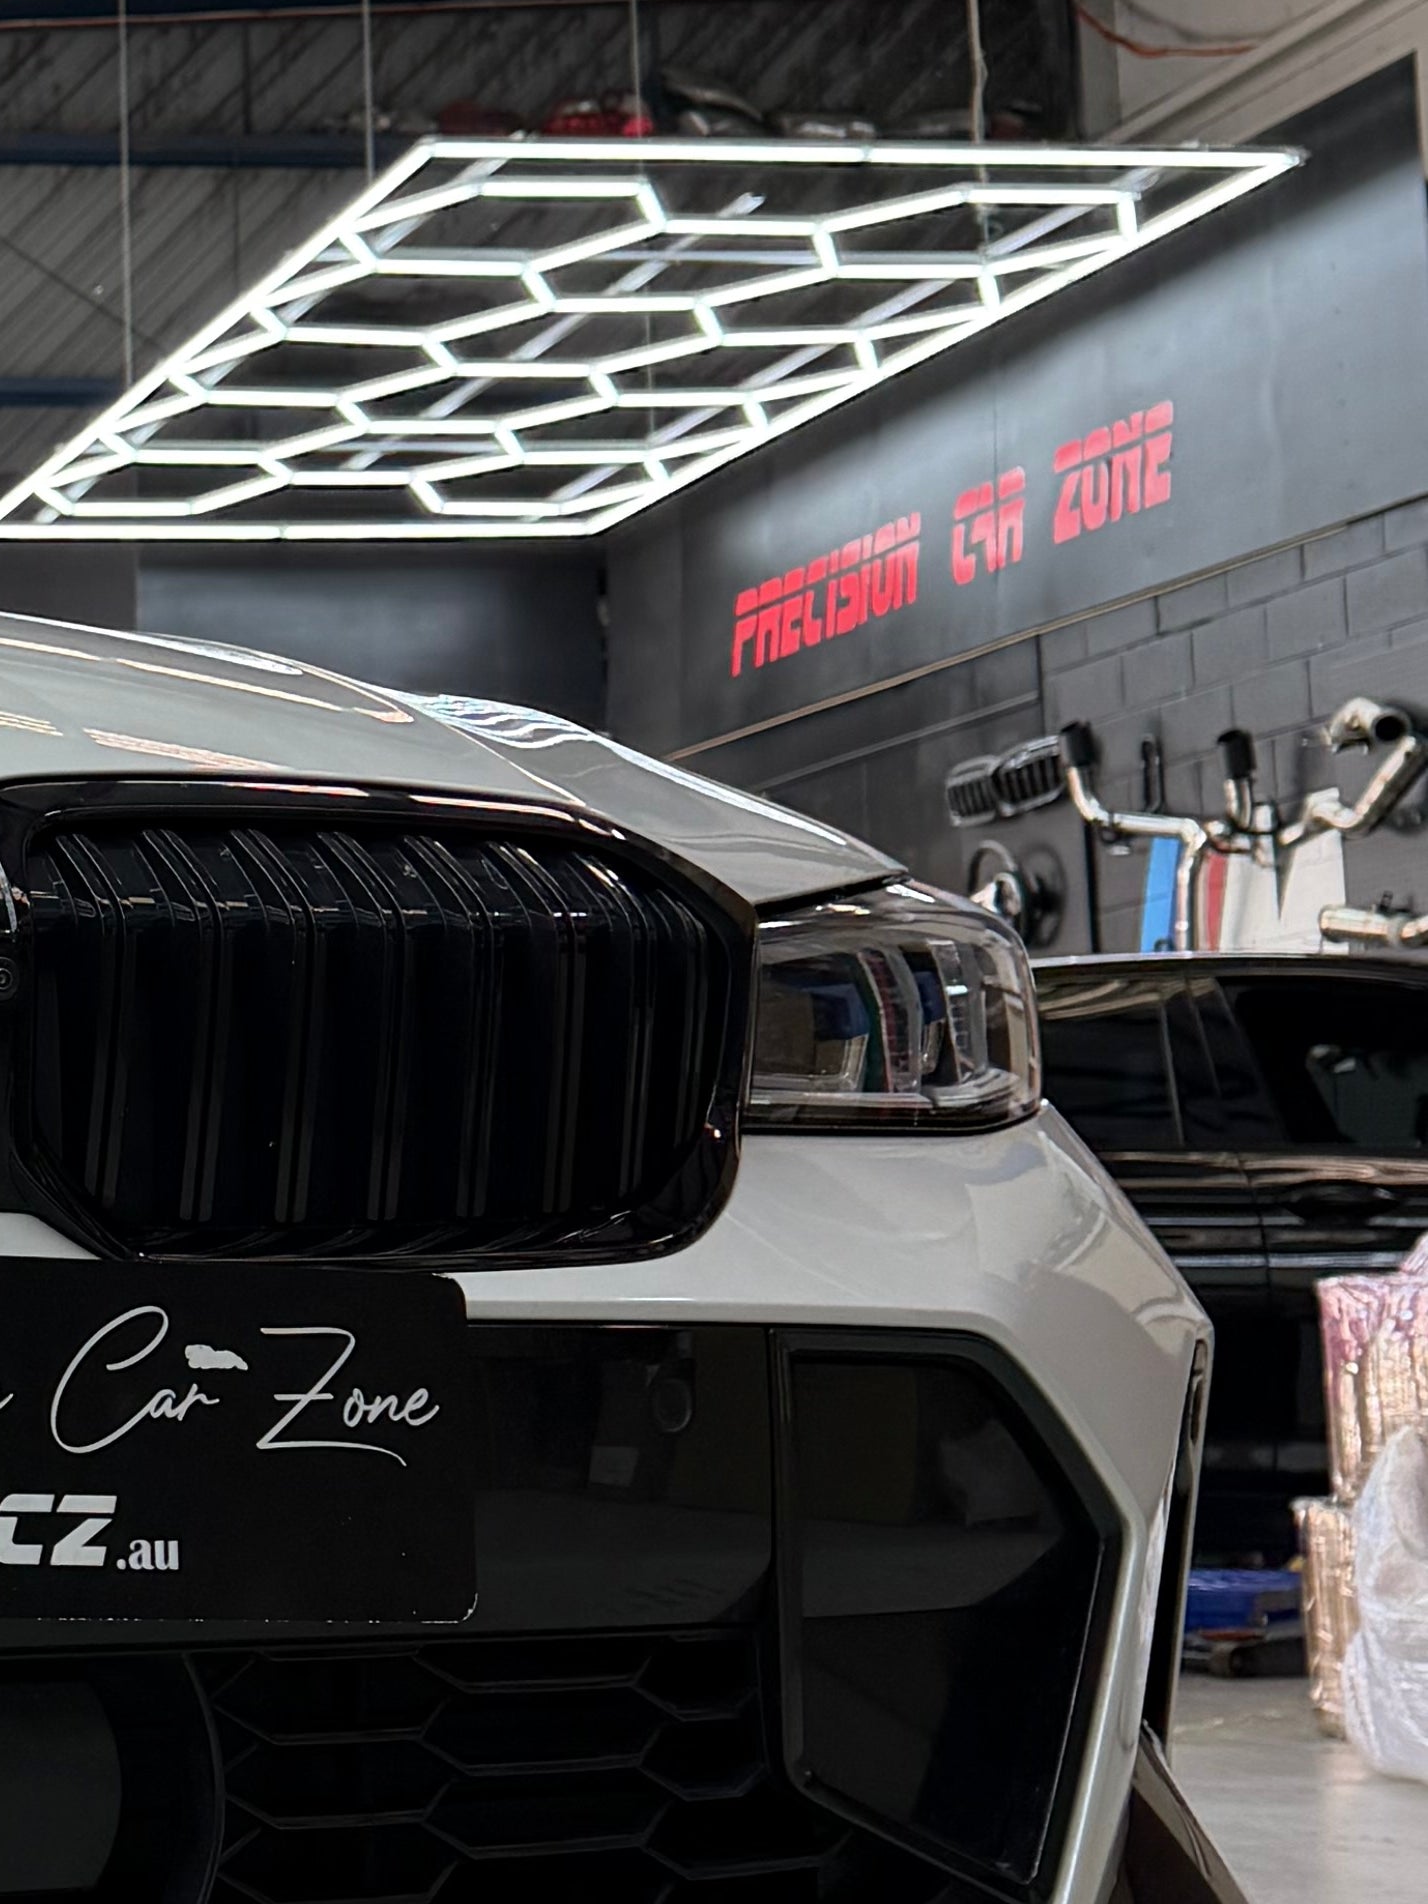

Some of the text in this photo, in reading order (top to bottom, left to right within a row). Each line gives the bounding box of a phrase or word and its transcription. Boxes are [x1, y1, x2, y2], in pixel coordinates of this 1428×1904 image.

[730, 399, 1174, 678] PRECISION CAR ZONE
[50, 1305, 220, 1453] Car
[255, 1326, 440, 1467] Zone
